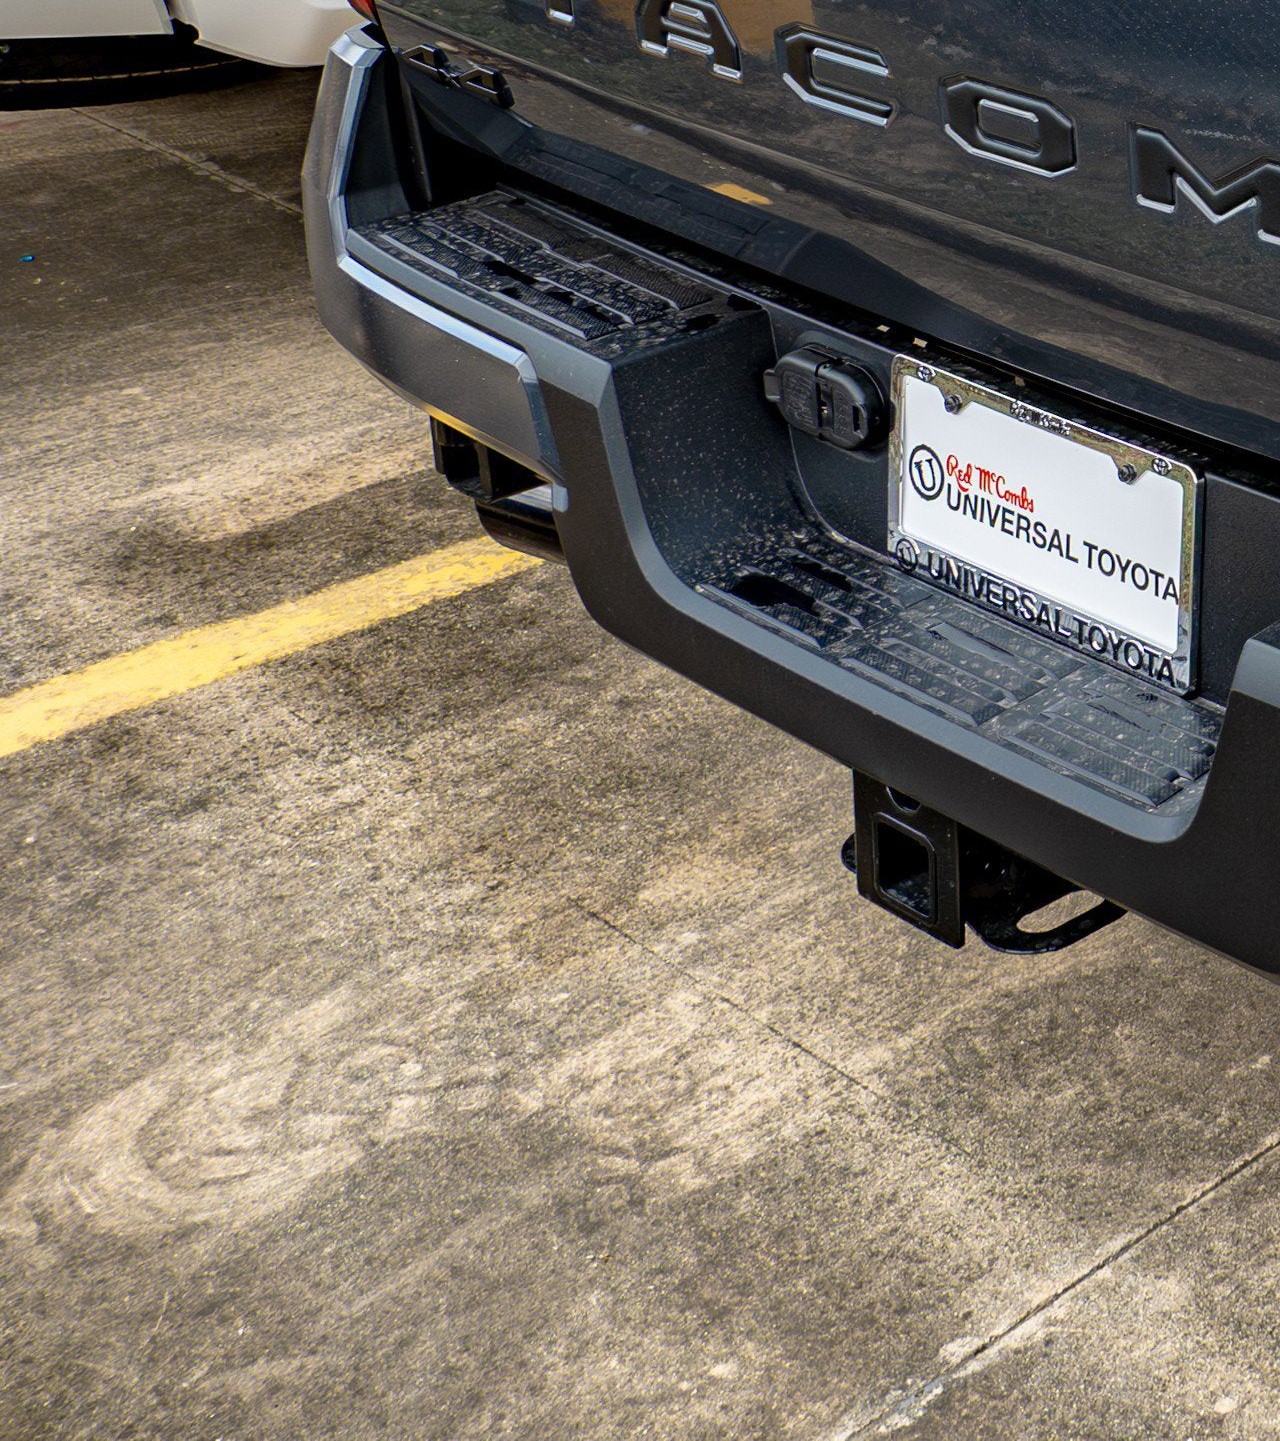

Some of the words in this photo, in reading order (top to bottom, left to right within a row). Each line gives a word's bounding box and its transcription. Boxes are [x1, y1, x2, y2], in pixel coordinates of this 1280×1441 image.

[946, 454, 972, 493] Red
[975, 464, 1034, 513] McCombs
[946, 482, 1079, 564] UNIVERSAL
[1082, 540, 1180, 606] TOYOTA
[927, 550, 1071, 638] UNIVERSAL
[1072, 613, 1177, 687] TOYOTA
